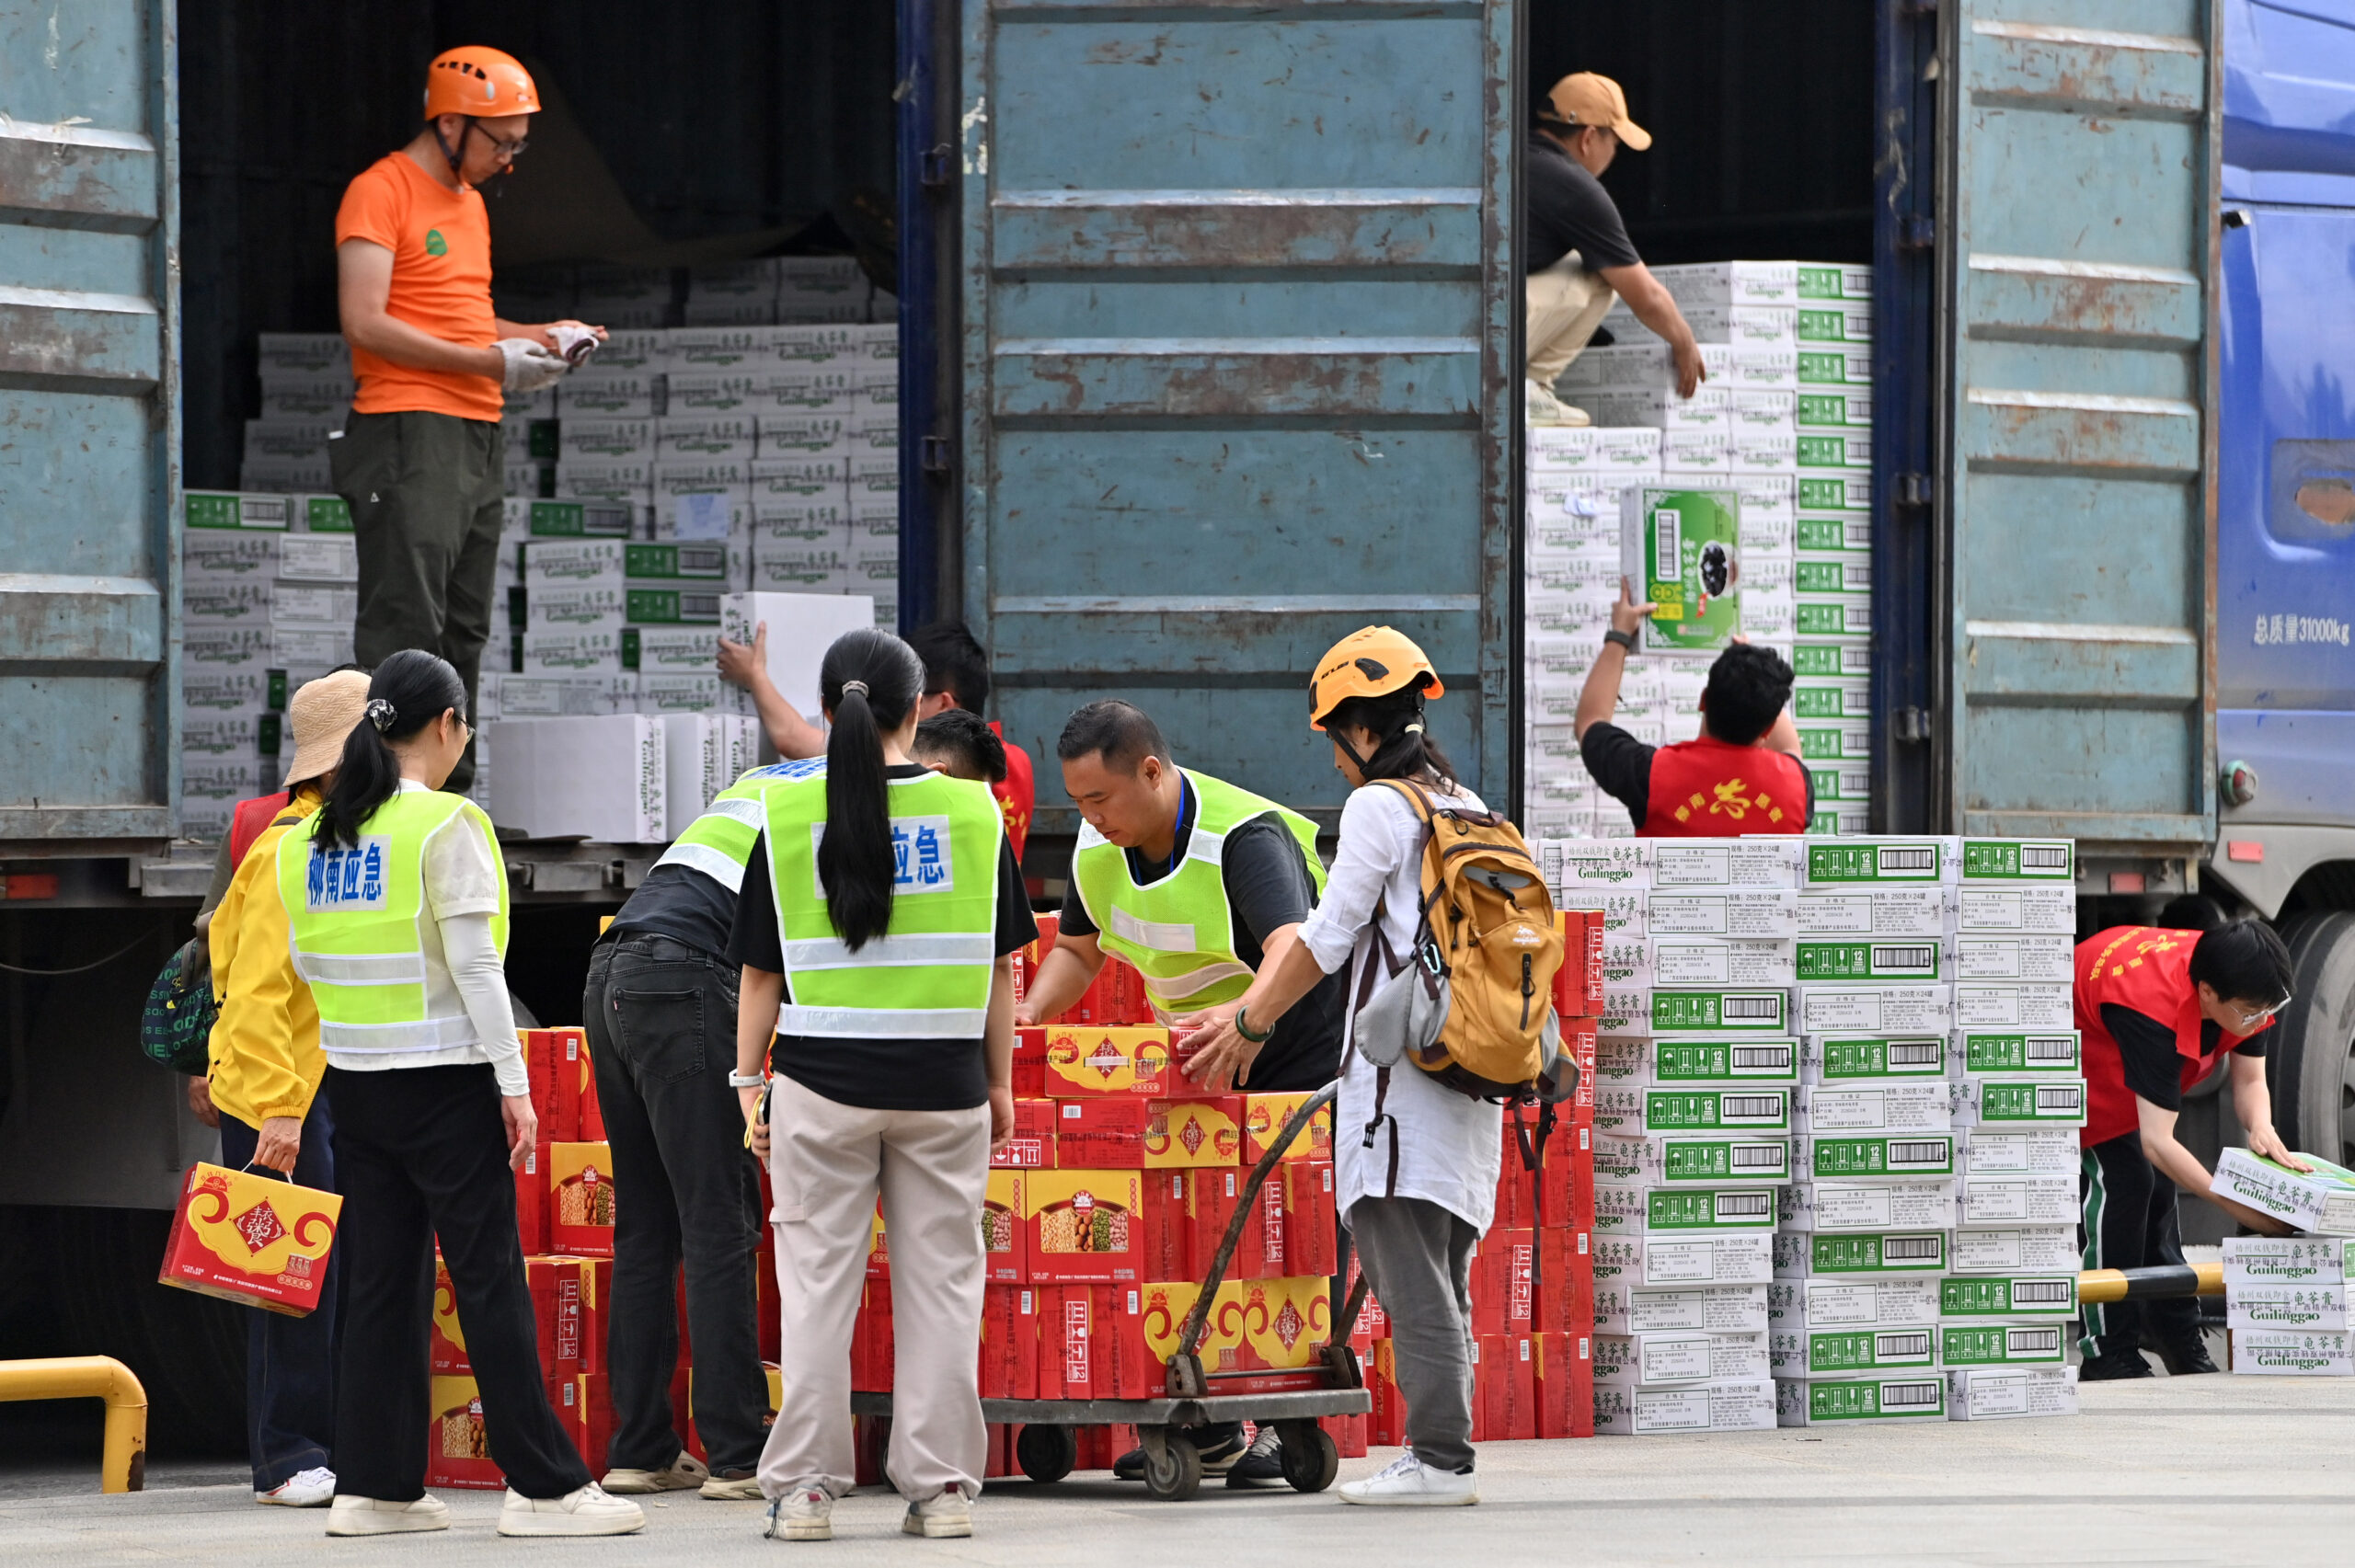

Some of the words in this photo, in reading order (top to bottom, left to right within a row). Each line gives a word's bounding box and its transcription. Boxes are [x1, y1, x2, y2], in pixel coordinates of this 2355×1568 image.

[2254, 614, 2349, 647] 总质量31000kg
[891, 826, 944, 884] 应急
[1613, 846, 1643, 861] 龟苓膏
[1862, 853, 1870, 862] 12
[2007, 851, 2015, 860] 12
[308, 842, 381, 906] 柳南应急
[1579, 867, 1632, 883] Guilinggao
[1608, 897, 1637, 912] 龟苓膏
[1614, 945, 1644, 960] 龟苓膏
[1854, 951, 1863, 960] 12
[1608, 996, 1640, 1010] 龟苓膏
[1706, 1000, 1715, 1010] 12
[1615, 1043, 1646, 1059] 龟苓膏
[1873, 1047, 1880, 1058] 12
[2012, 1042, 2019, 1052] 12
[1713, 1051, 1722, 1061] 12
[1596, 1063, 1633, 1079] ilinggao
[1605, 1093, 1636, 1107] 龟苓膏
[2024, 1091, 2030, 1102] 12
[1705, 1100, 1713, 1109] 12
[1620, 1143, 1654, 1158] 龟苓膏
[1716, 1150, 1723, 1159] 12
[1870, 1146, 1879, 1156] 12
[1603, 1191, 1636, 1205] 龟苓膏
[2234, 1181, 2295, 1214] Guilinggao
[2278, 1181, 2314, 1205] 龟苓膏
[1700, 1198, 1707, 1208] 12
[1600, 1242, 1633, 1256] 龟苓膏
[1867, 1242, 1875, 1252] 12
[2292, 1244, 2332, 1258] 龟苓膏
[2246, 1264, 2317, 1276] Guilinggao
[1995, 1286, 2004, 1296] 12
[2295, 1291, 2333, 1305] 龟苓膏
[2250, 1310, 2320, 1323] Guilinggao
[1859, 1339, 1867, 1348] 12
[1992, 1334, 1999, 1345] 12
[2304, 1336, 2344, 1349] 龟苓膏
[1597, 1342, 1629, 1357] 龟苓膏
[2257, 1356, 2329, 1368] Guilinggao
[1864, 1389, 1873, 1399] 12
